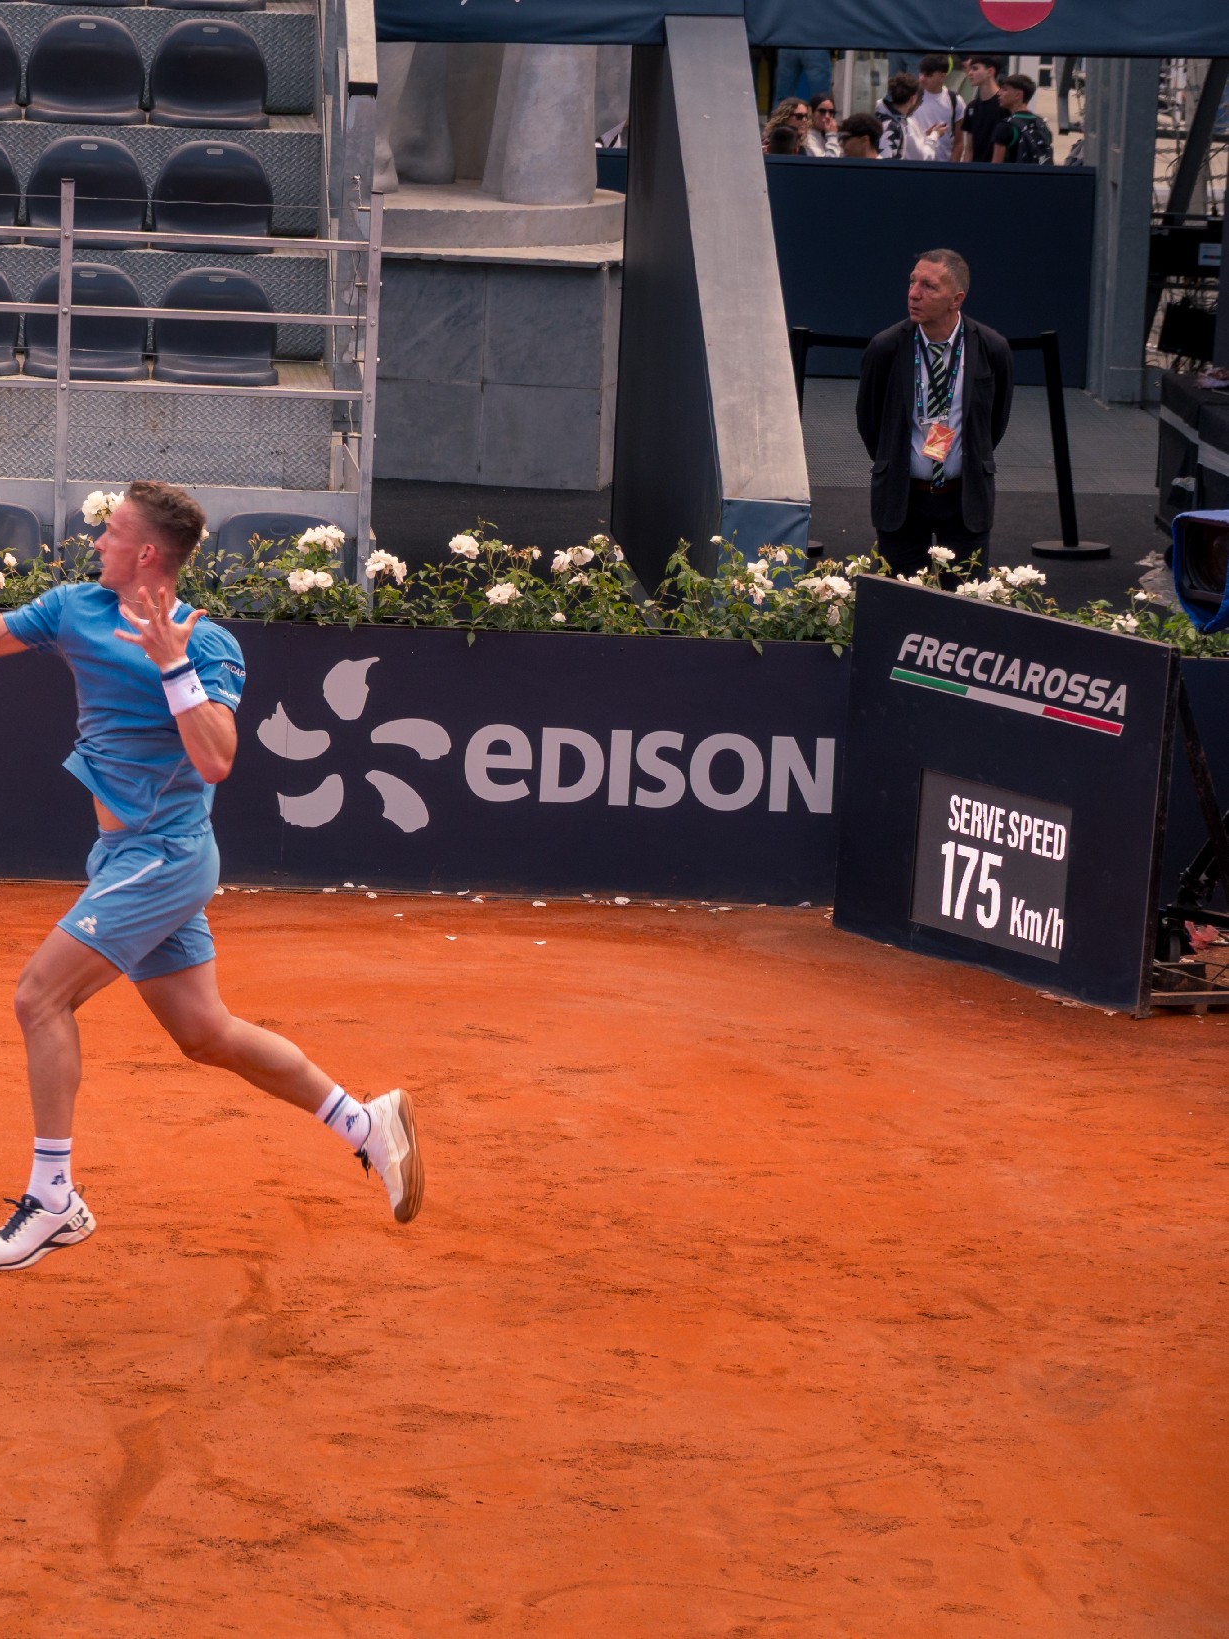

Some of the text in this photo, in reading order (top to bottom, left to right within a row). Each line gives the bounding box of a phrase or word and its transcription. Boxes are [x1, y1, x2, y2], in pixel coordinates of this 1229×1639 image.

[897, 633, 1127, 717] FRECCIAROSSA
[464, 723, 836, 814] eDISON
[948, 794, 1067, 861] SERVE SPEED
[940, 840, 1064, 950] 175 Km/h
